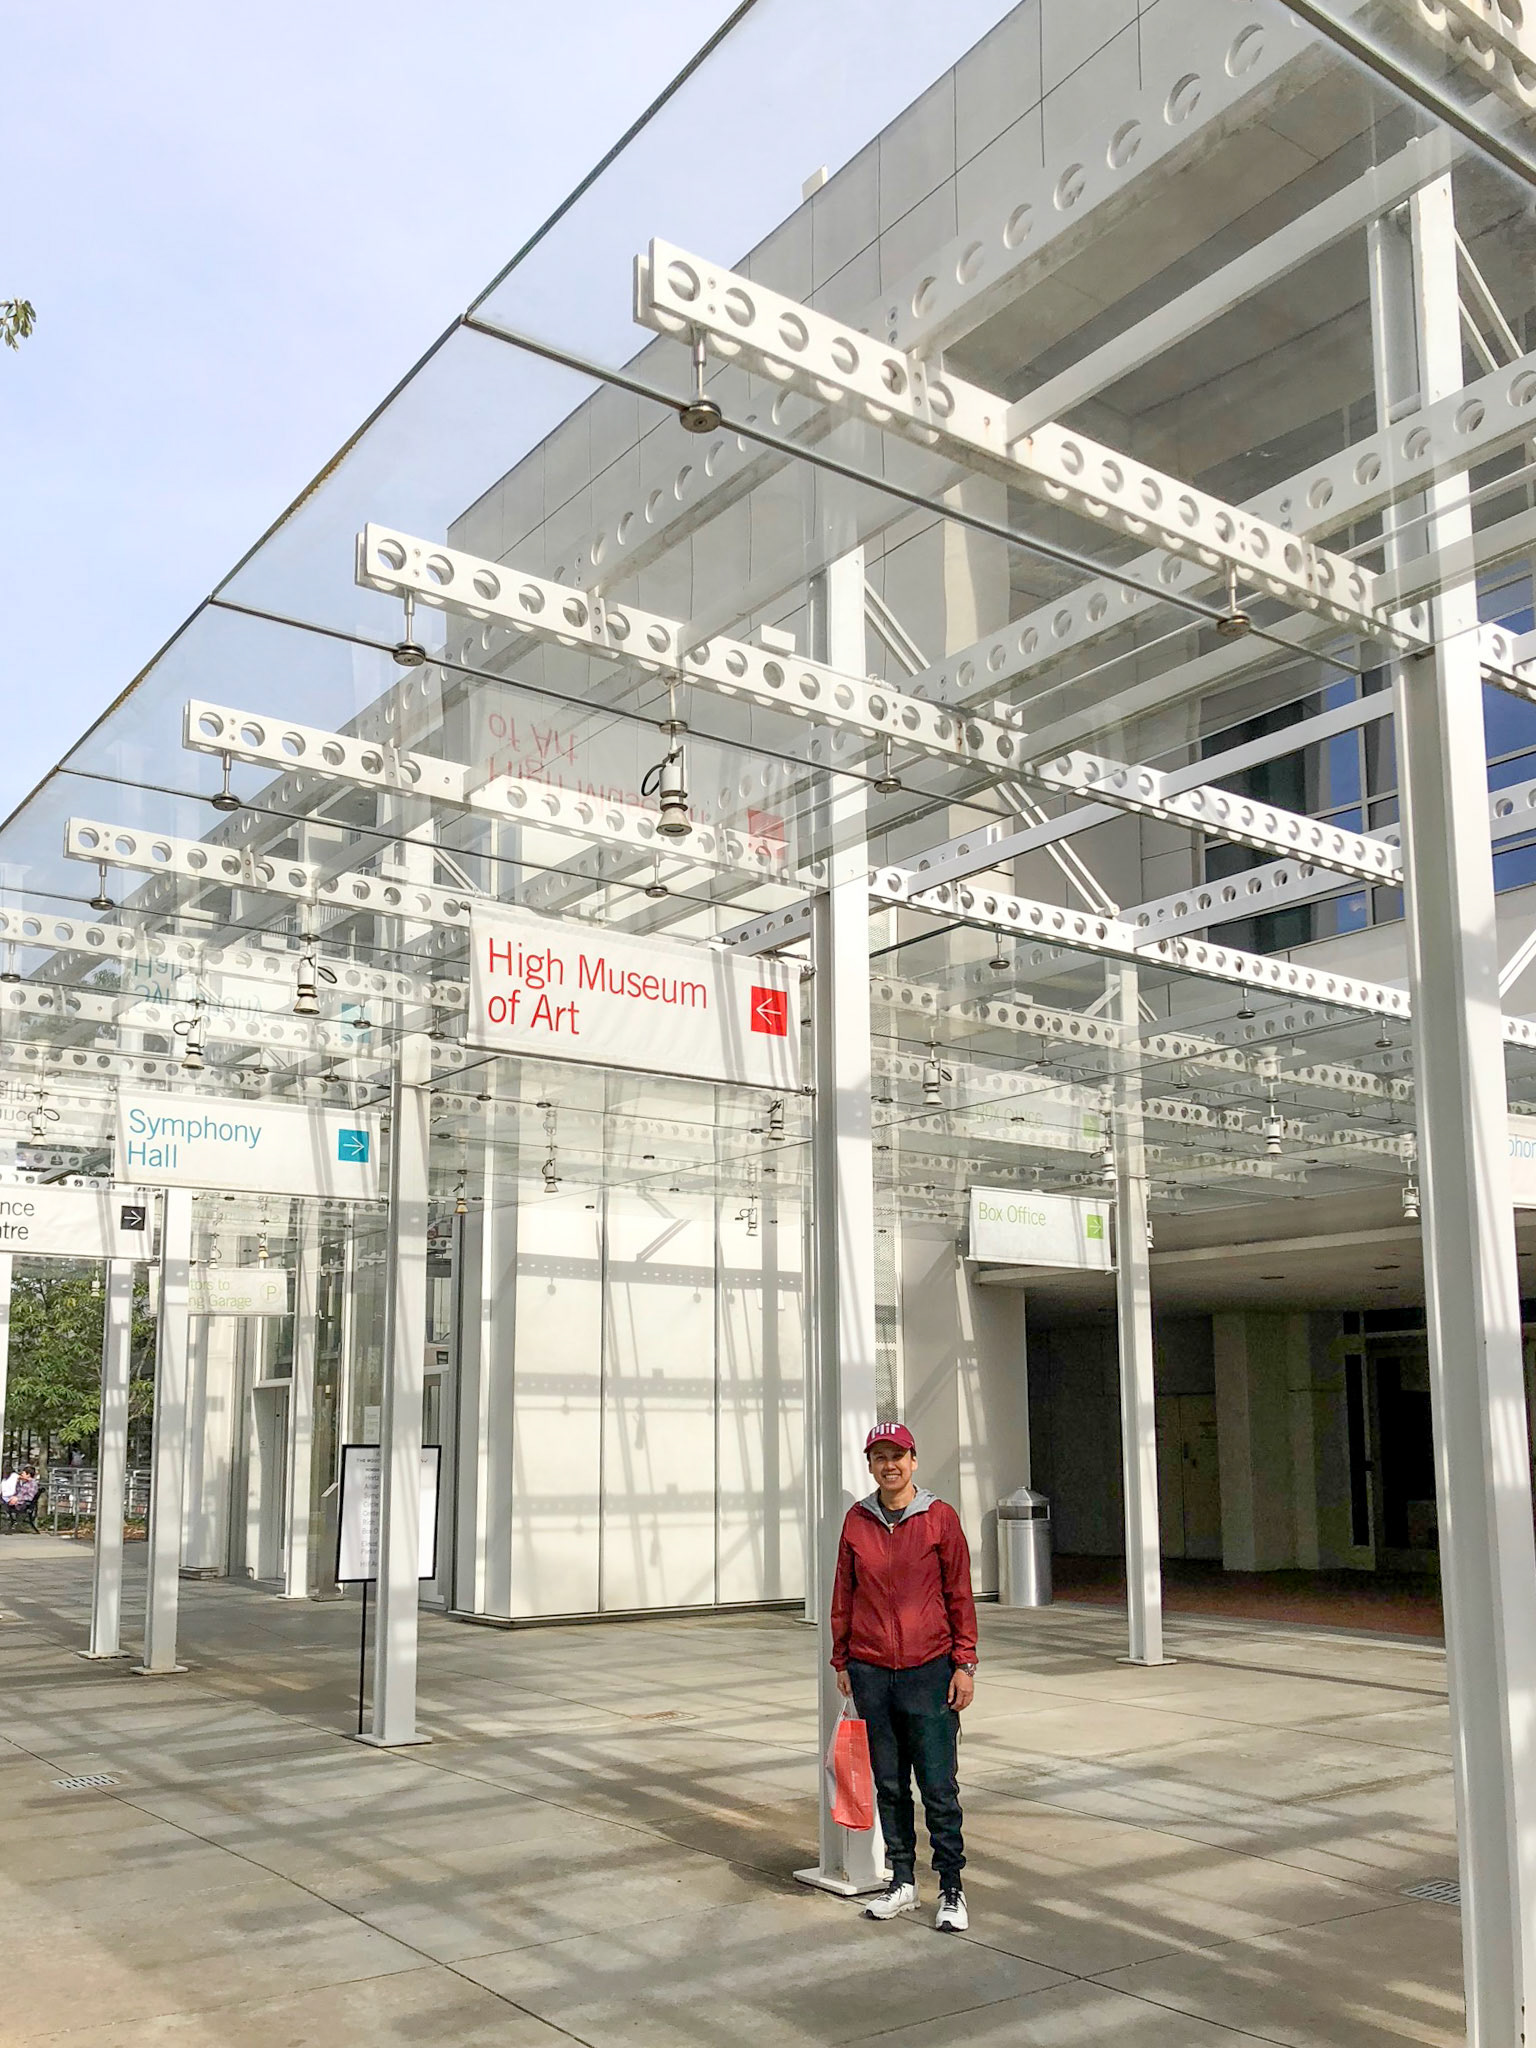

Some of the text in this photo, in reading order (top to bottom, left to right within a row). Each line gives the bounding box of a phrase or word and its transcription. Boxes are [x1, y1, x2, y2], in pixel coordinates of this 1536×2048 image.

[488, 937, 708, 1009] High Museum
[487, 988, 581, 1035] of Art
[128, 1108, 262, 1149] Symphony
[127, 1140, 178, 1168] Hall
[978, 1202, 1046, 1226] Box Office
[218, 1279, 230, 1291] to
[209, 1294, 251, 1309] Garage
